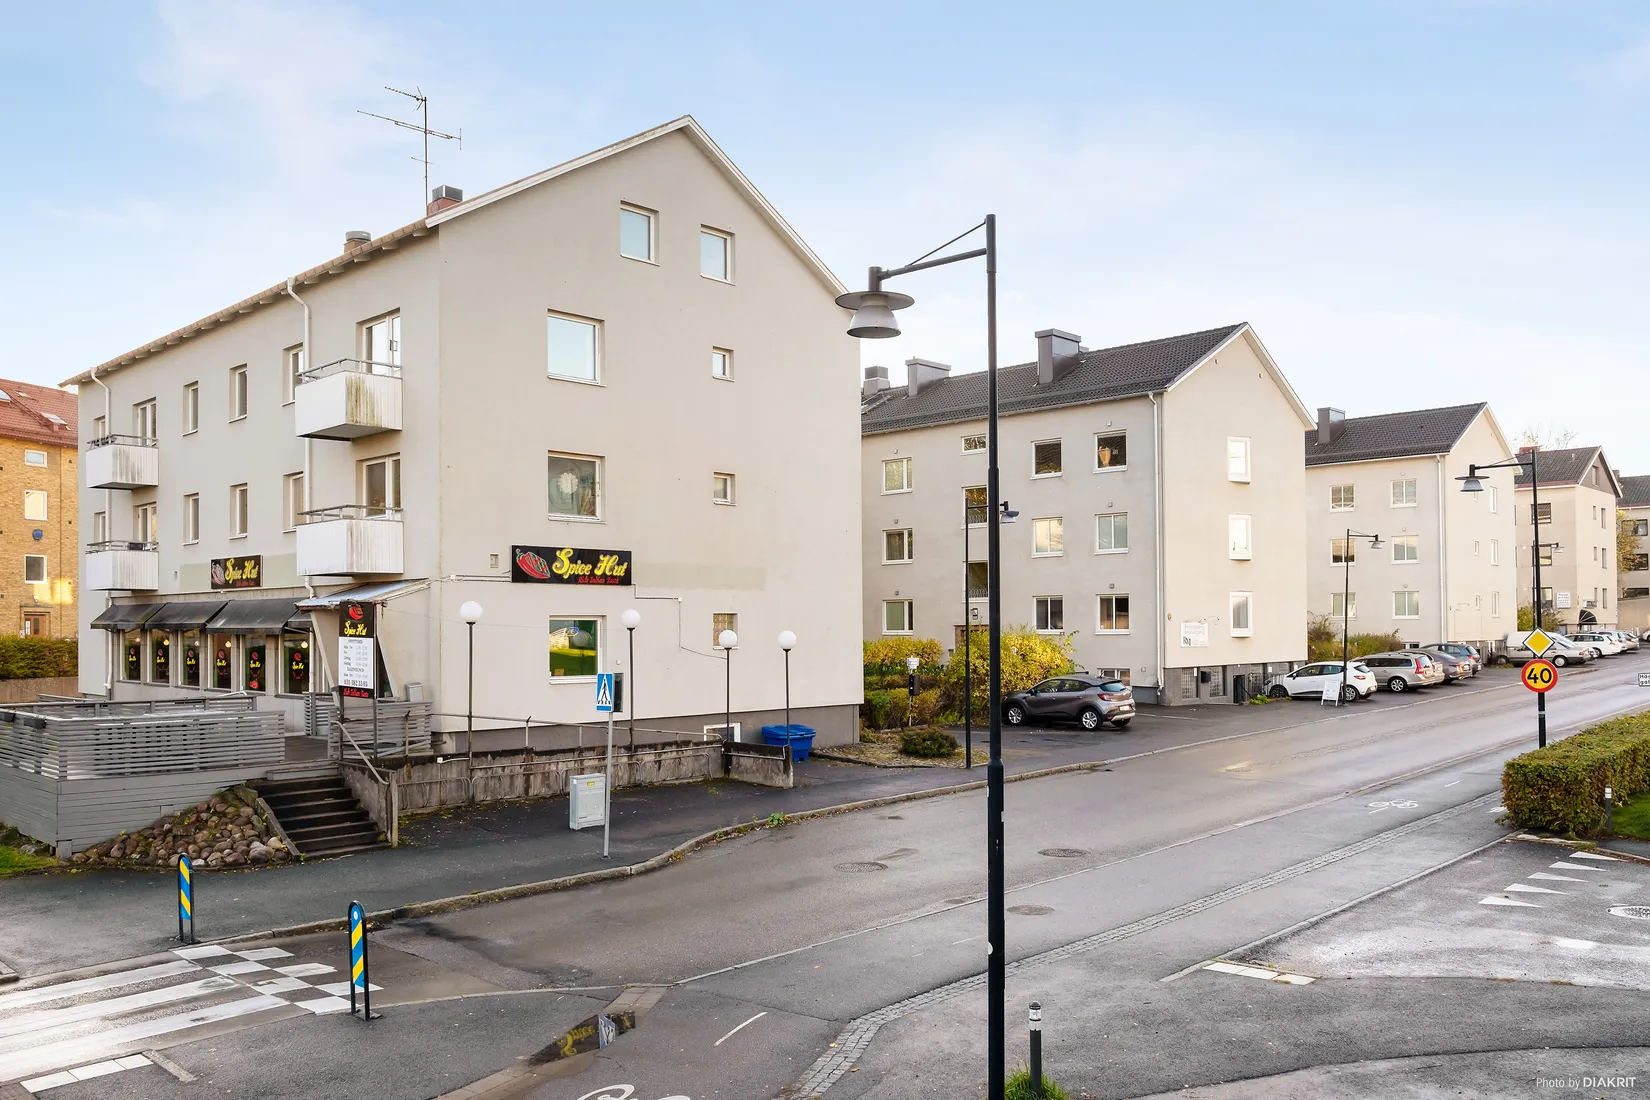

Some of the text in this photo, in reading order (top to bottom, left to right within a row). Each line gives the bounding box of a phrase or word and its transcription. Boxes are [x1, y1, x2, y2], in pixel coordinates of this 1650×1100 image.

[225, 558, 259, 584] Spice Hut
[552, 548, 628, 579] Spice Hut
[344, 621, 367, 637] Spice Hut
[1527, 668, 1552, 684] 40
